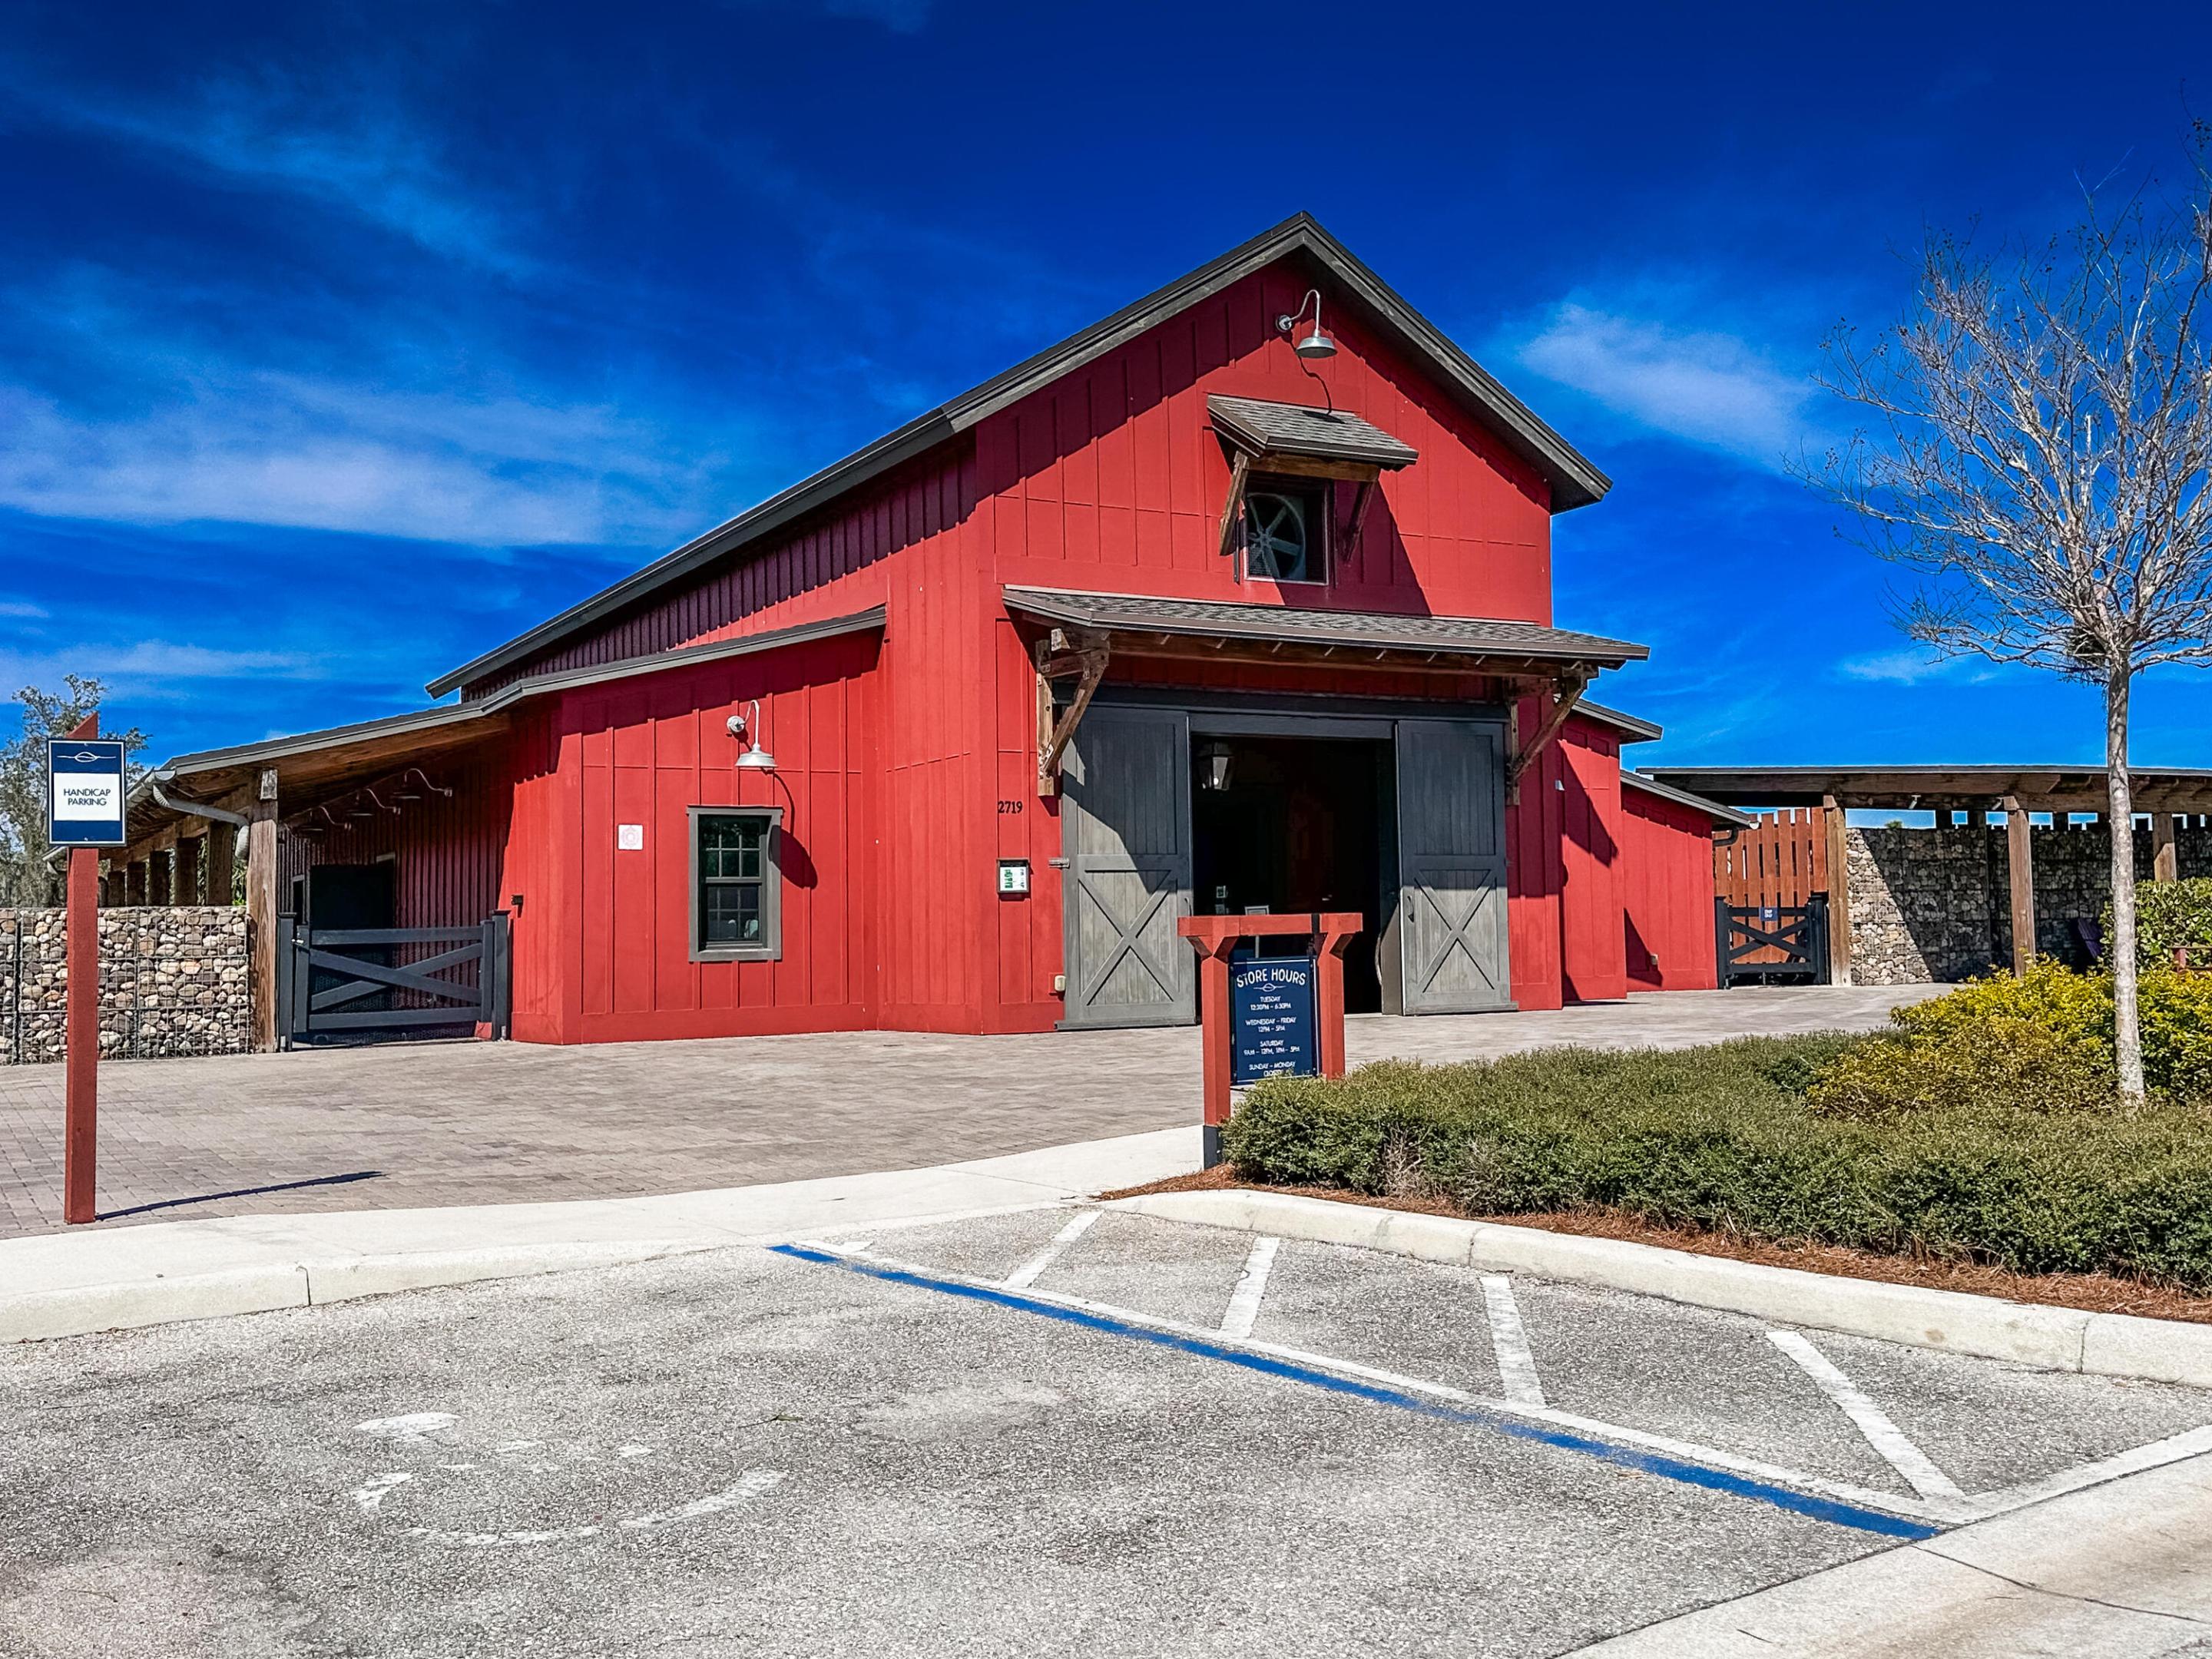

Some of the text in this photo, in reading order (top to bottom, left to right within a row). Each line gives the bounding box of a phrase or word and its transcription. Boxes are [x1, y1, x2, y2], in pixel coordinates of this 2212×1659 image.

[63, 788, 111, 796] HANDICAP
[68, 797, 107, 806] PARKING
[998, 801, 1022, 814] 2719
[1237, 969, 1306, 988] STORE HOURS
